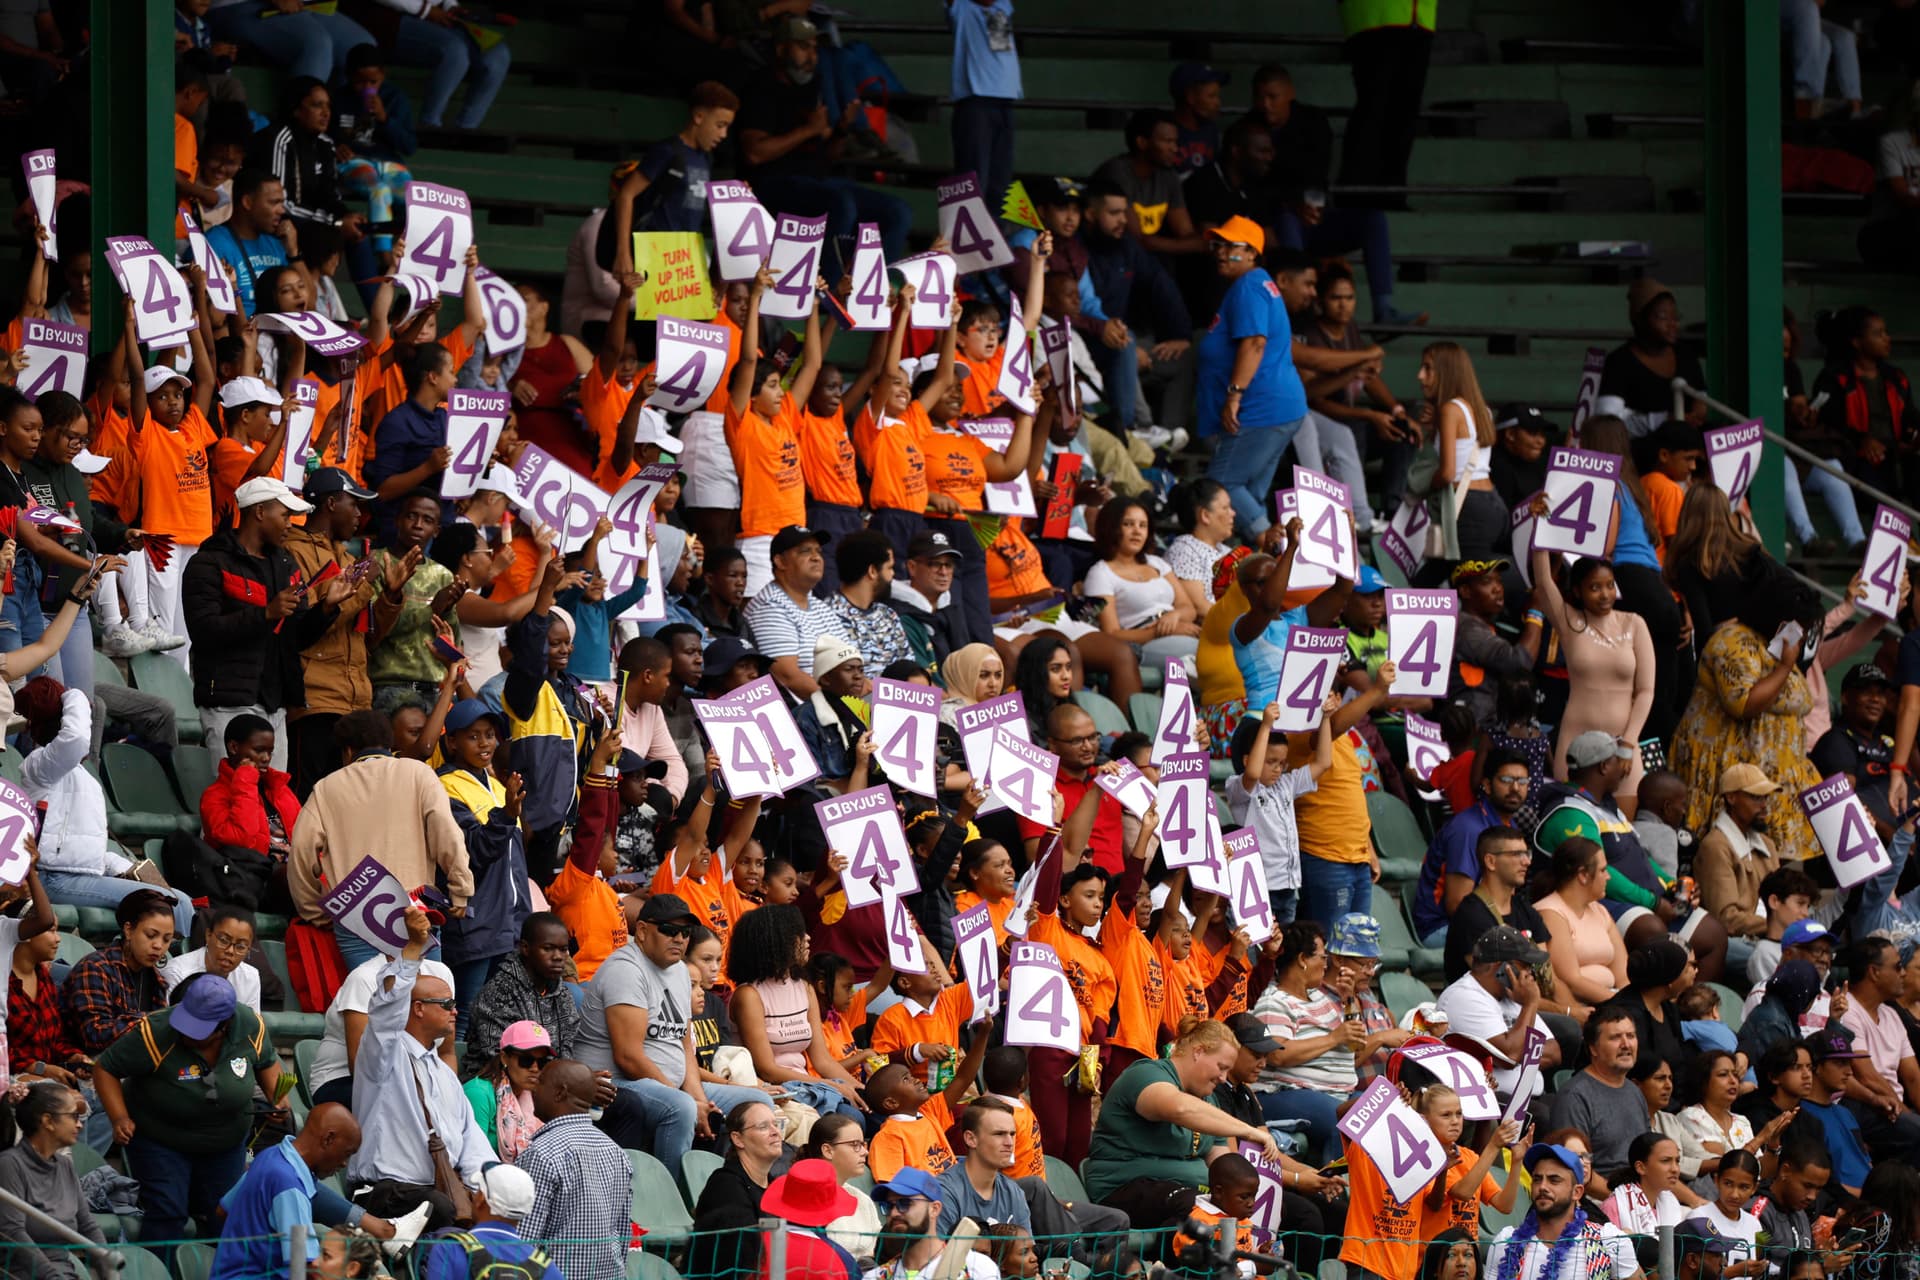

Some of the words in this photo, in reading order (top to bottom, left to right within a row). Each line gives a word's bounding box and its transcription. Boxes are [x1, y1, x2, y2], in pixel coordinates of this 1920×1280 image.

[428, 189, 466, 208] BYJU'S
[411, 216, 456, 282] 4
[662, 248, 691, 267] TURN
[728, 207, 773, 266] 4
[952, 205, 994, 261] 4
[142, 258, 180, 323] 4
[206, 240, 227, 303] 4
[654, 282, 701, 305] VOLUME
[658, 270, 672, 286] UP
[676, 264, 695, 281] THE
[773, 246, 816, 310] 4
[855, 254, 884, 319] 4
[918, 260, 950, 318] 4
[45, 327, 84, 346] BYJU'S
[482, 283, 520, 340] 6
[680, 325, 724, 343] BYJU'S
[658, 350, 706, 406] 4
[1008, 339, 1031, 398] 4
[468, 396, 505, 412] BYJU'S
[453, 422, 489, 488] 4
[1726, 424, 1760, 446] BYJU'S
[1313, 474, 1344, 501] BYJU'S
[1570, 454, 1614, 473] BYJU'S
[534, 480, 598, 538] 6
[613, 484, 650, 548] 4
[1308, 504, 1344, 564] 4
[1547, 480, 1596, 545] 4
[1409, 596, 1452, 610] BYJU'S
[1870, 544, 1902, 606] 4
[1310, 635, 1344, 648] BYJU'S
[1398, 620, 1440, 687] 4
[712, 704, 746, 718] BYJU'S
[894, 688, 934, 706] BYJU'S
[978, 700, 1018, 723] BYJU'S
[1286, 658, 1328, 723] 4
[881, 715, 924, 783] 4
[1162, 692, 1190, 754] 4
[731, 726, 770, 784] 4
[1012, 741, 1052, 768] BYJU'S
[1168, 759, 1204, 774] BYJU'S
[840, 793, 886, 814] BYJU'S
[998, 767, 1041, 816] 4
[1819, 778, 1850, 802] BYJU
[1162, 784, 1196, 856] 4
[1836, 802, 1880, 864] 4
[850, 820, 900, 886] 4
[338, 866, 378, 904] BYJU'S
[1238, 860, 1269, 928] 4
[362, 892, 412, 950] 6
[890, 899, 914, 962] 4
[966, 908, 988, 931] BYJU'S
[977, 937, 996, 1007] 4
[1036, 949, 1062, 968] BYJ
[779, 1028, 810, 1037] Visionary
[780, 1019, 804, 1028] Fashion
[1018, 976, 1070, 1038] 4
[1830, 1038, 1846, 1050] 15
[1358, 1084, 1390, 1121] BYJU'S
[1446, 1056, 1487, 1109] 4
[1386, 1113, 1432, 1178] 4
[1375, 1223, 1398, 1234] WORLD
[1399, 1228, 1412, 1236] CUP
